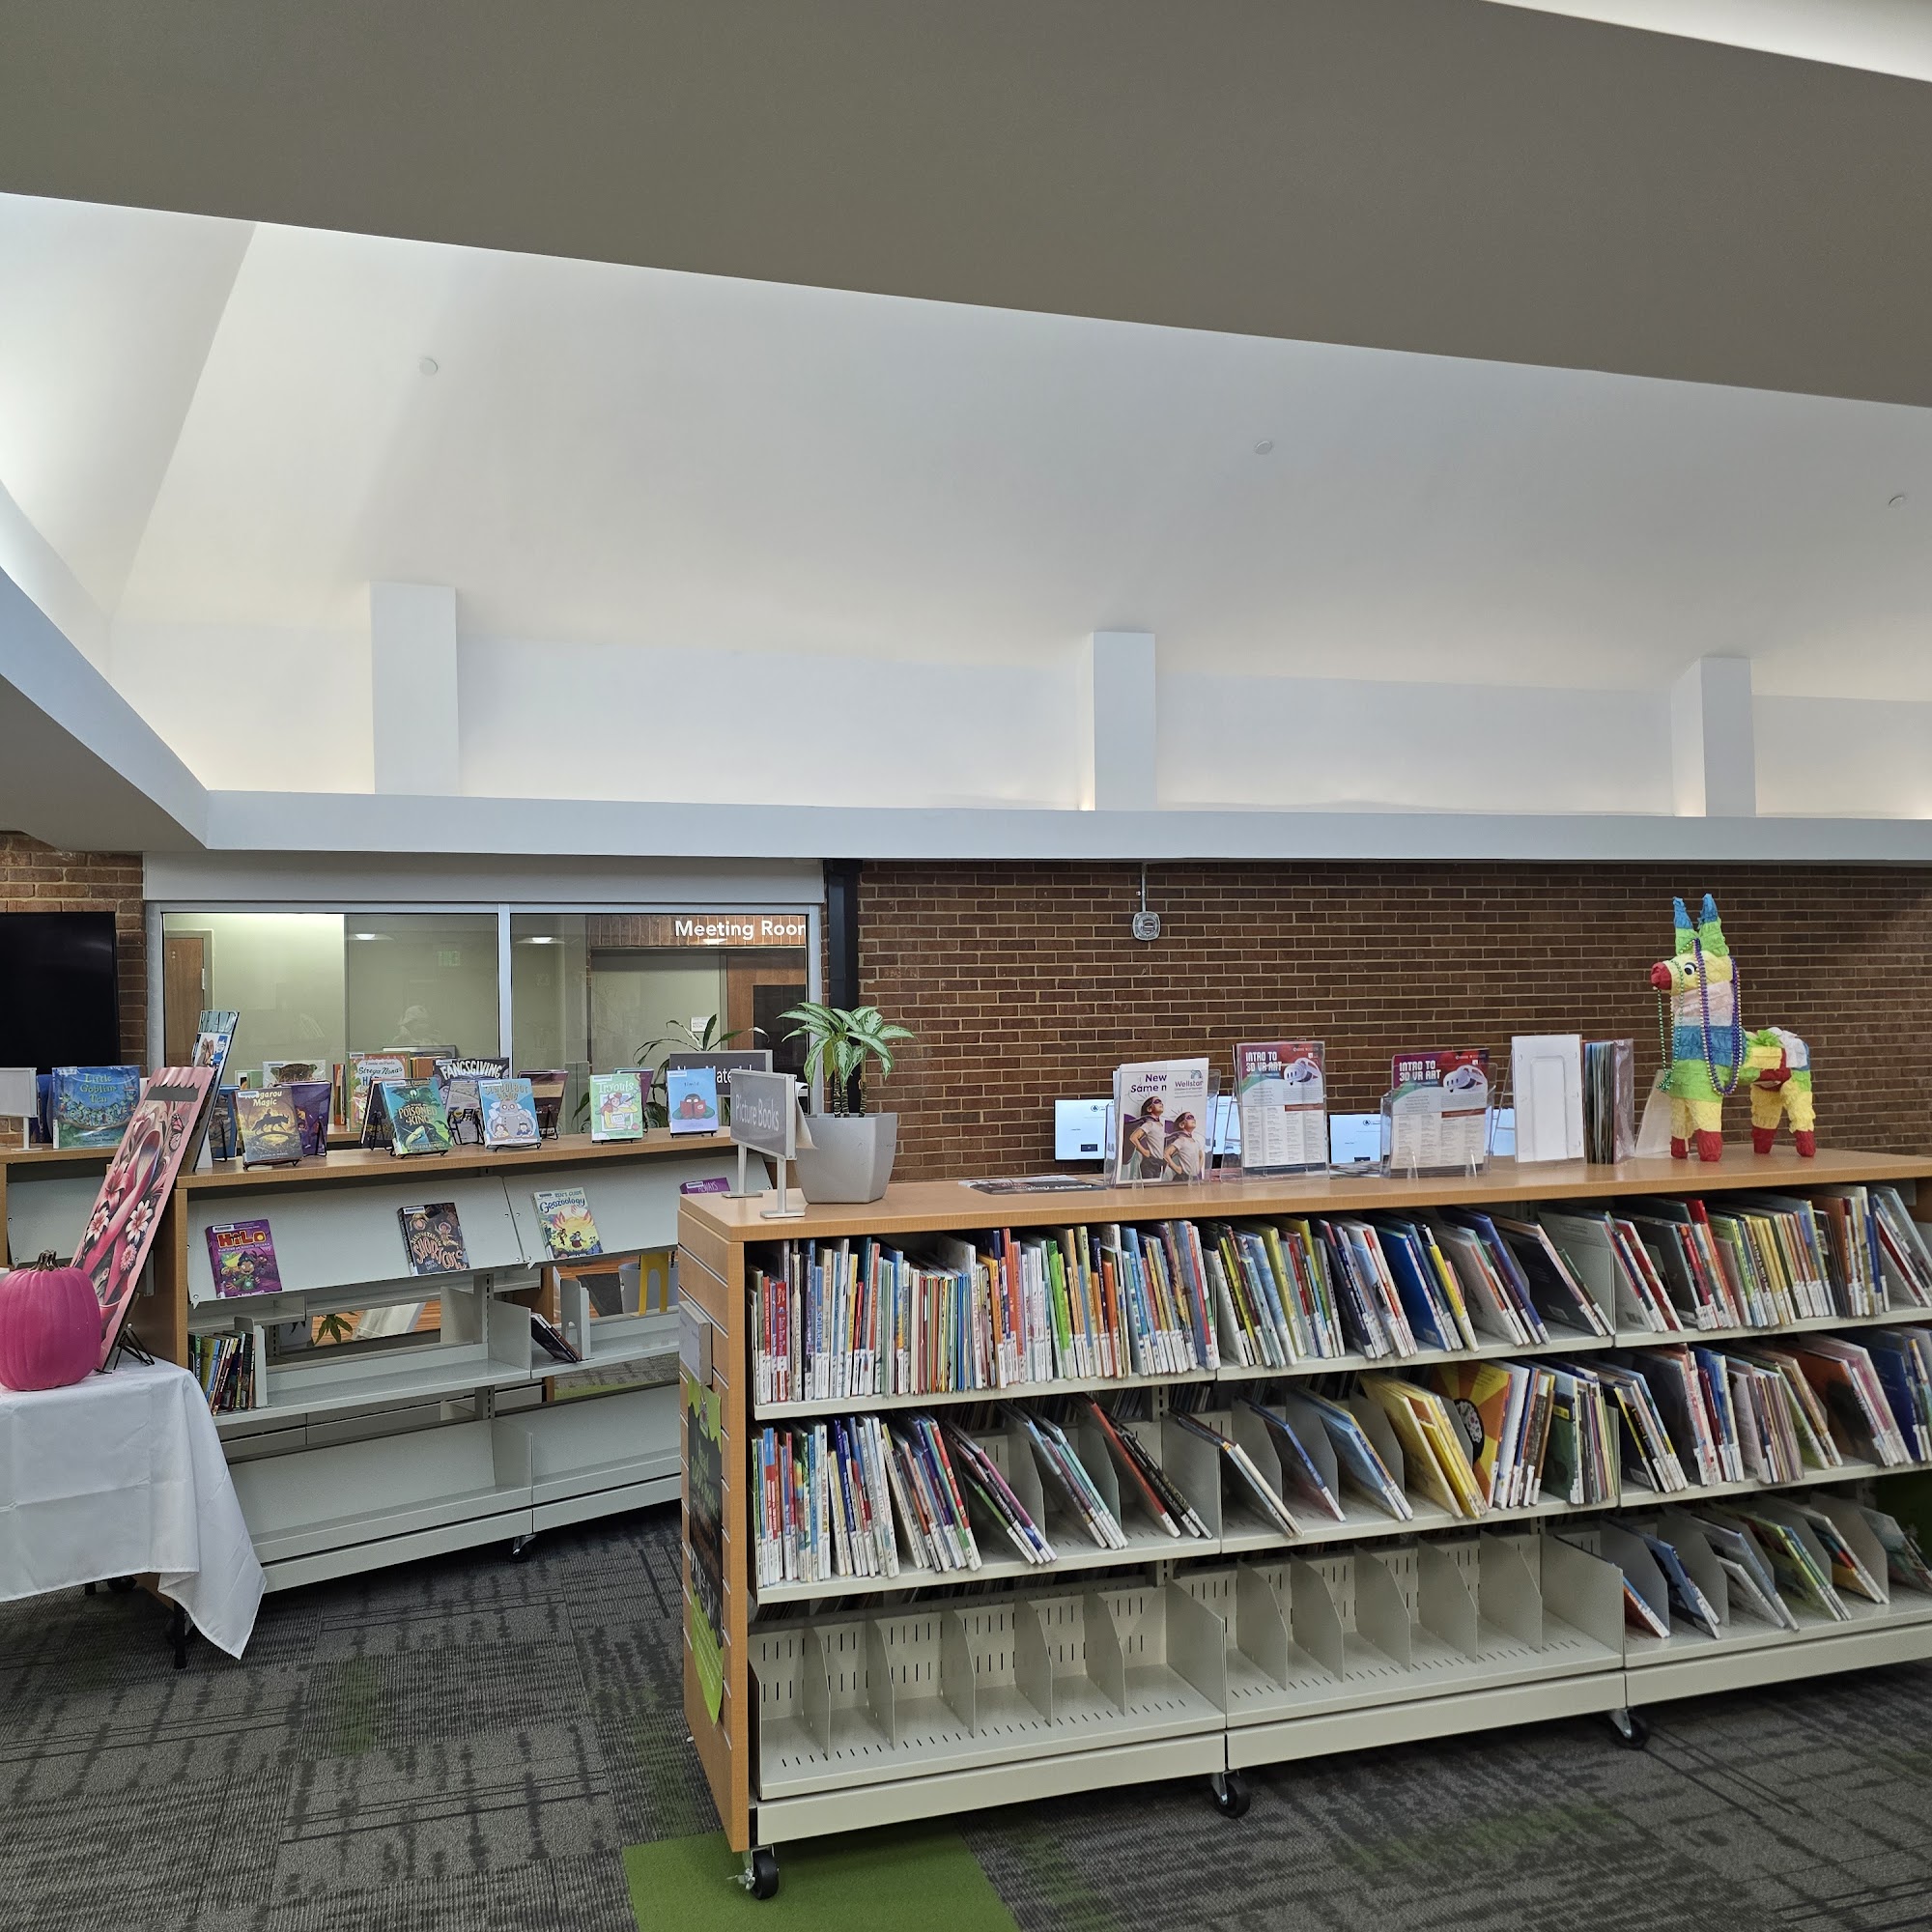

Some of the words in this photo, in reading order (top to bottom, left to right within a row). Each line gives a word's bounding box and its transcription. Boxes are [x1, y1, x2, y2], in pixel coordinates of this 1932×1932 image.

[674, 920, 754, 941] Meeting
[1245, 1051, 1266, 1062] INTRO
[1267, 1051, 1278, 1061] TO
[358, 1066, 381, 1075] Strega
[440, 1060, 503, 1080] FANGSGIVING
[1245, 1062, 1256, 1072] 3D
[1257, 1062, 1267, 1072] VR
[1267, 1061, 1283, 1071] ART
[1399, 1061, 1423, 1071] INTRO
[1425, 1060, 1436, 1070] TO
[83, 1073, 112, 1083] Little
[1145, 1073, 1168, 1082] New
[1399, 1071, 1410, 1082] 3D
[1411, 1070, 1424, 1081] VR
[1425, 1069, 1442, 1080] ART
[79, 1084, 117, 1094] Goblins
[596, 1081, 635, 1094] Tryouts
[1130, 1084, 1159, 1094] Same
[89, 1094, 108, 1104] Ten
[252, 1097, 277, 1107] Magic
[398, 1105, 438, 1120] POISONED
[735, 1094, 756, 1125] Picture
[757, 1100, 780, 1132] Books
[539, 1197, 585, 1214] Geozoology
